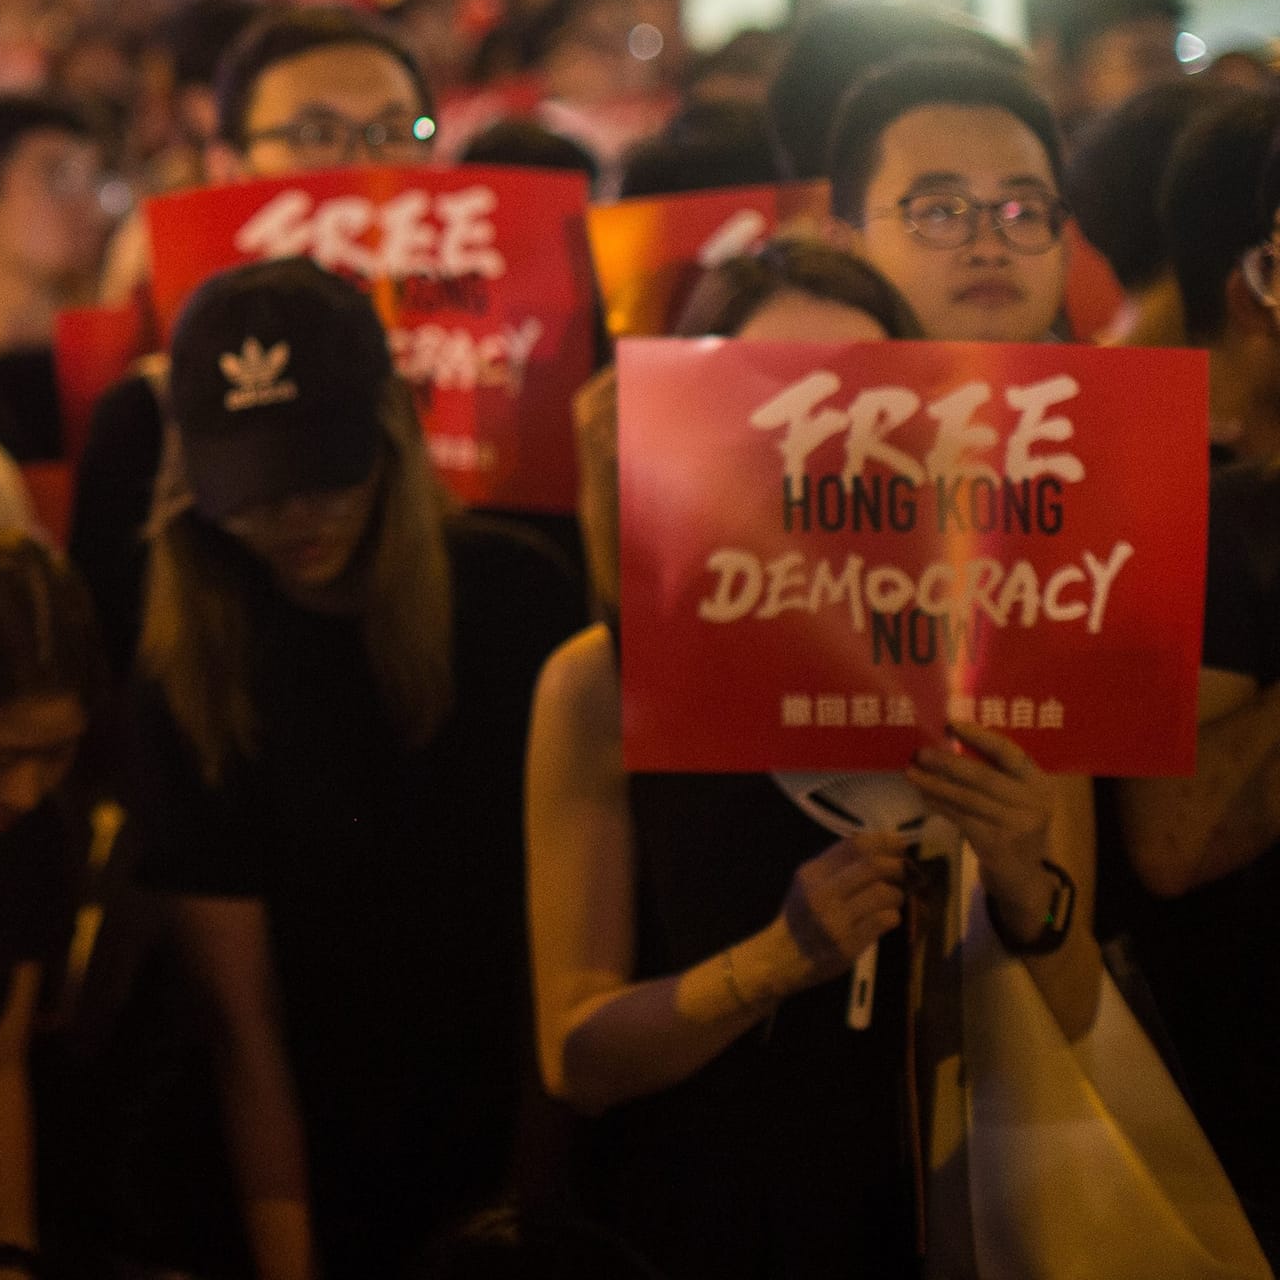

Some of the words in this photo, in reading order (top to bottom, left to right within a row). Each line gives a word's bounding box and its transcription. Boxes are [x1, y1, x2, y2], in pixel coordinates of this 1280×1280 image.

[233, 184, 507, 281] FREE
[748, 370, 1086, 501] FREE
[781, 473, 918, 535] HONG
[934, 473, 1065, 537] KONG
[697, 540, 1135, 635] DEMOCRACY
[870, 610, 985, 667] NOW
